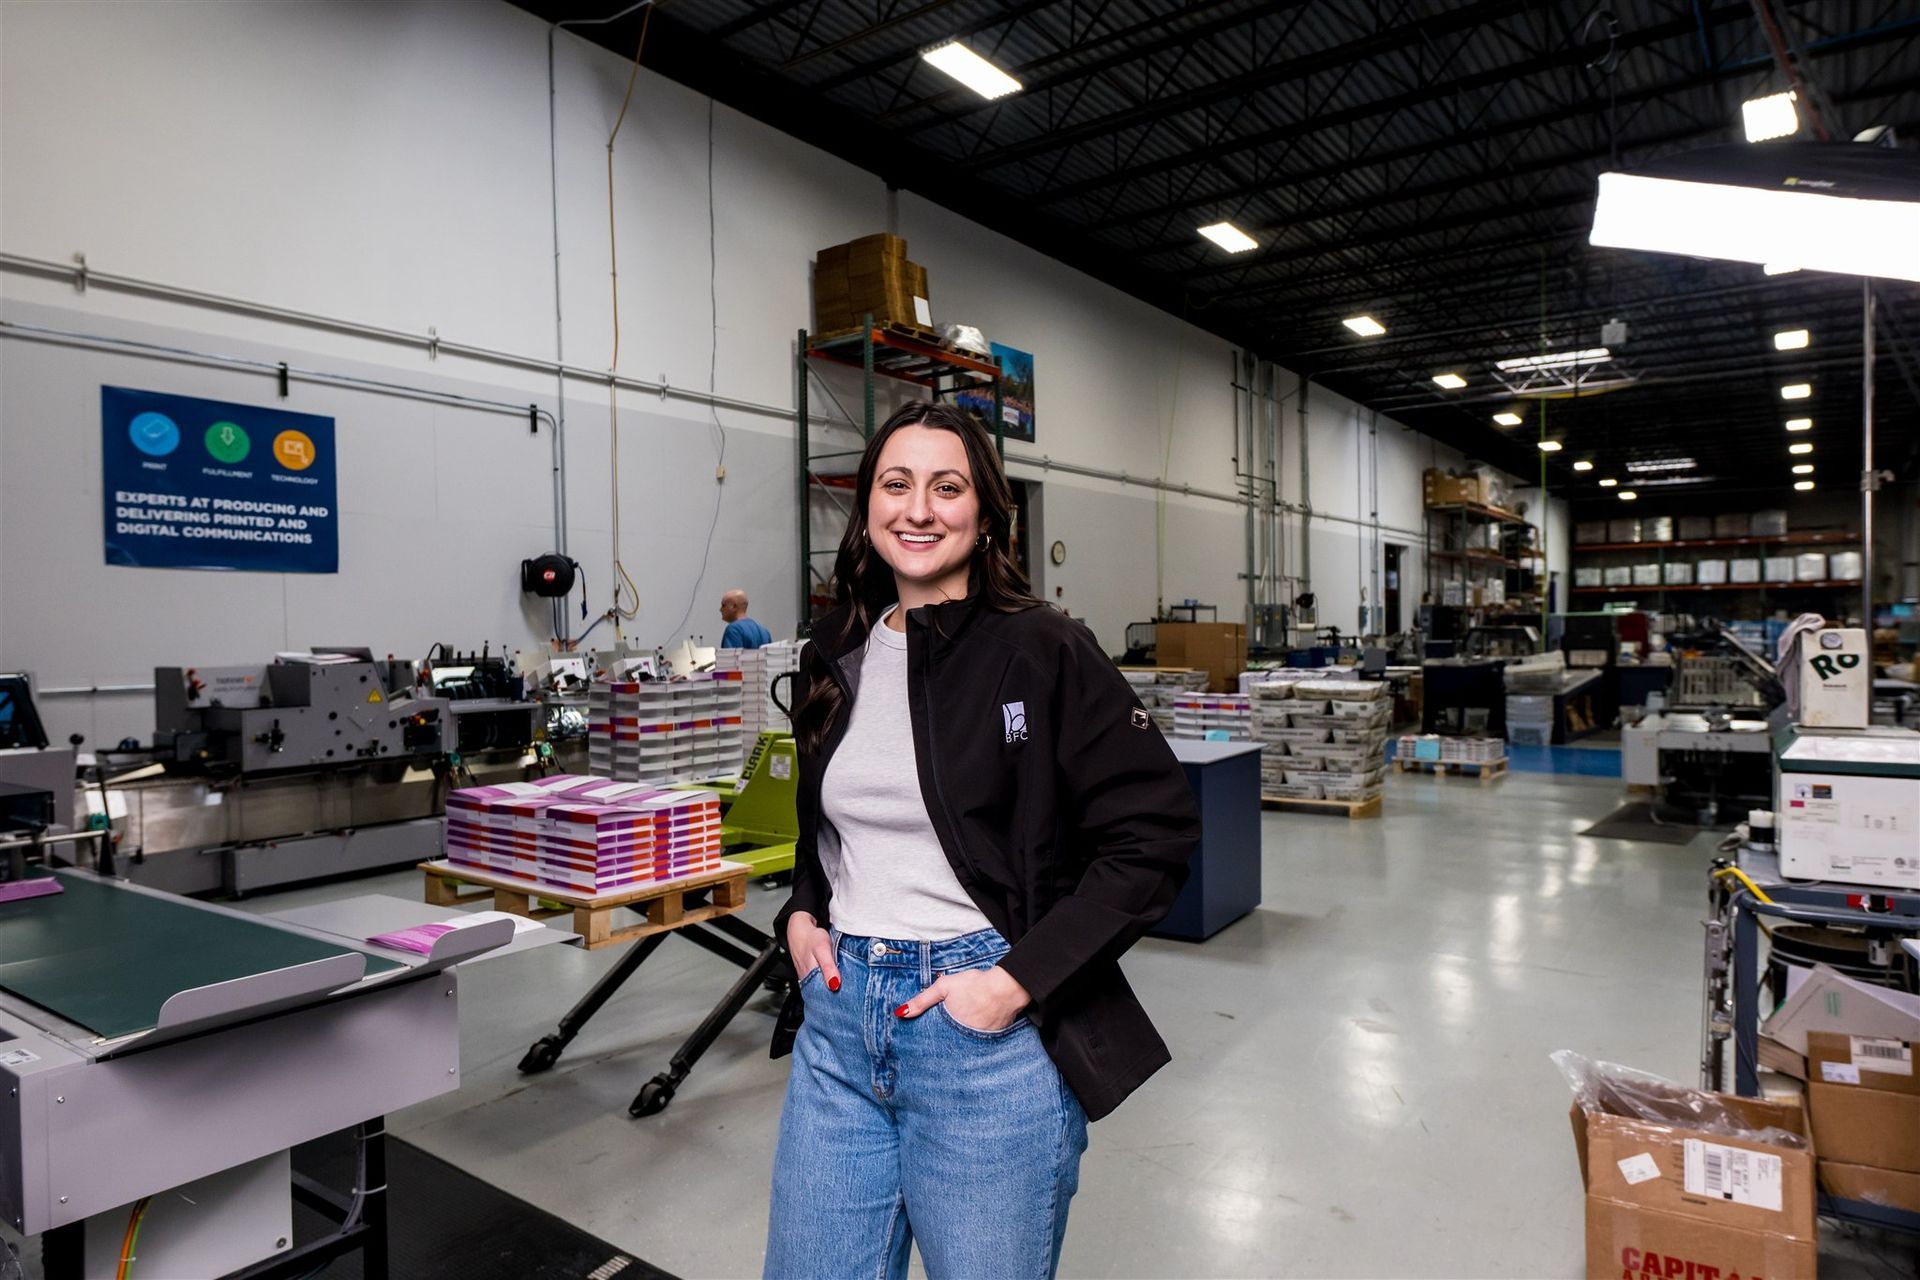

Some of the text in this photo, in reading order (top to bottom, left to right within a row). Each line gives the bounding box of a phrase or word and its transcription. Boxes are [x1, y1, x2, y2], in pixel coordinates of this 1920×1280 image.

[202, 467, 253, 479] FULFILLMENT
[271, 474, 318, 485] TECHNOLOGY
[115, 490, 329, 518] EXPERTS AT PRODUCING AND
[116, 506, 307, 530] DELIVERING PRINTED AND
[116, 522, 313, 544] DIGITAL COMMUNICATIONS
[1006, 730, 1029, 744] BFC
[741, 735, 770, 780] CLARK
